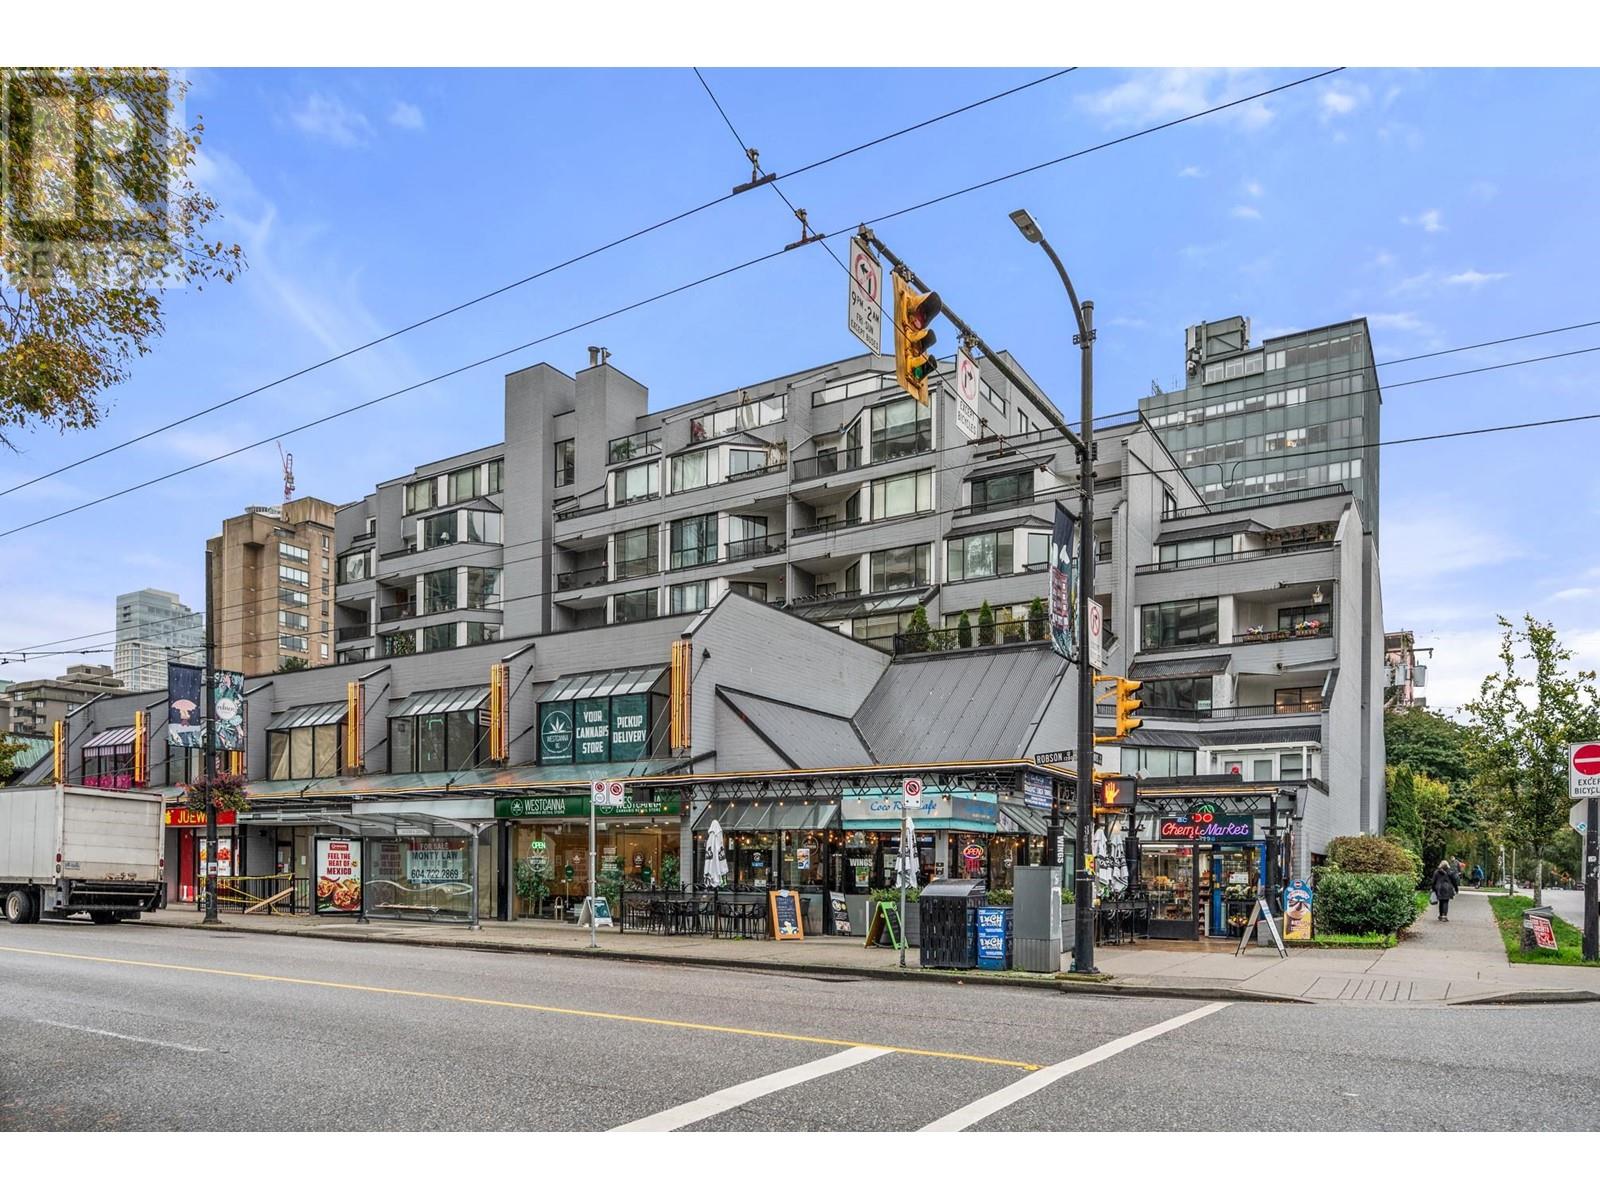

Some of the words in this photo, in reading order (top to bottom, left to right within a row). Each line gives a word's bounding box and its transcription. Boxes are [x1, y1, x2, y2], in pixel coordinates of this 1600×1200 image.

[583, 711, 603, 723] YOUR
[617, 715, 643, 729] PICKUP
[576, 725, 609, 739] CANNABIS
[612, 730, 647, 744] DELIVERY
[582, 741, 604, 754] STORE
[1036, 753, 1063, 764] ROBSON
[524, 798, 566, 811] WESTCANNA
[870, 800, 891, 811] Coco
[178, 811, 208, 824] JUEW
[1200, 822, 1249, 836] Market
[532, 841, 546, 849] OPEN
[1057, 835, 1065, 864] WINGS
[412, 851, 439, 860] MONTY
[442, 851, 458, 860] LAW
[965, 847, 982, 856] OPEN
[850, 858, 873, 867] WINGS
[326, 867, 352, 875] MEXICO
